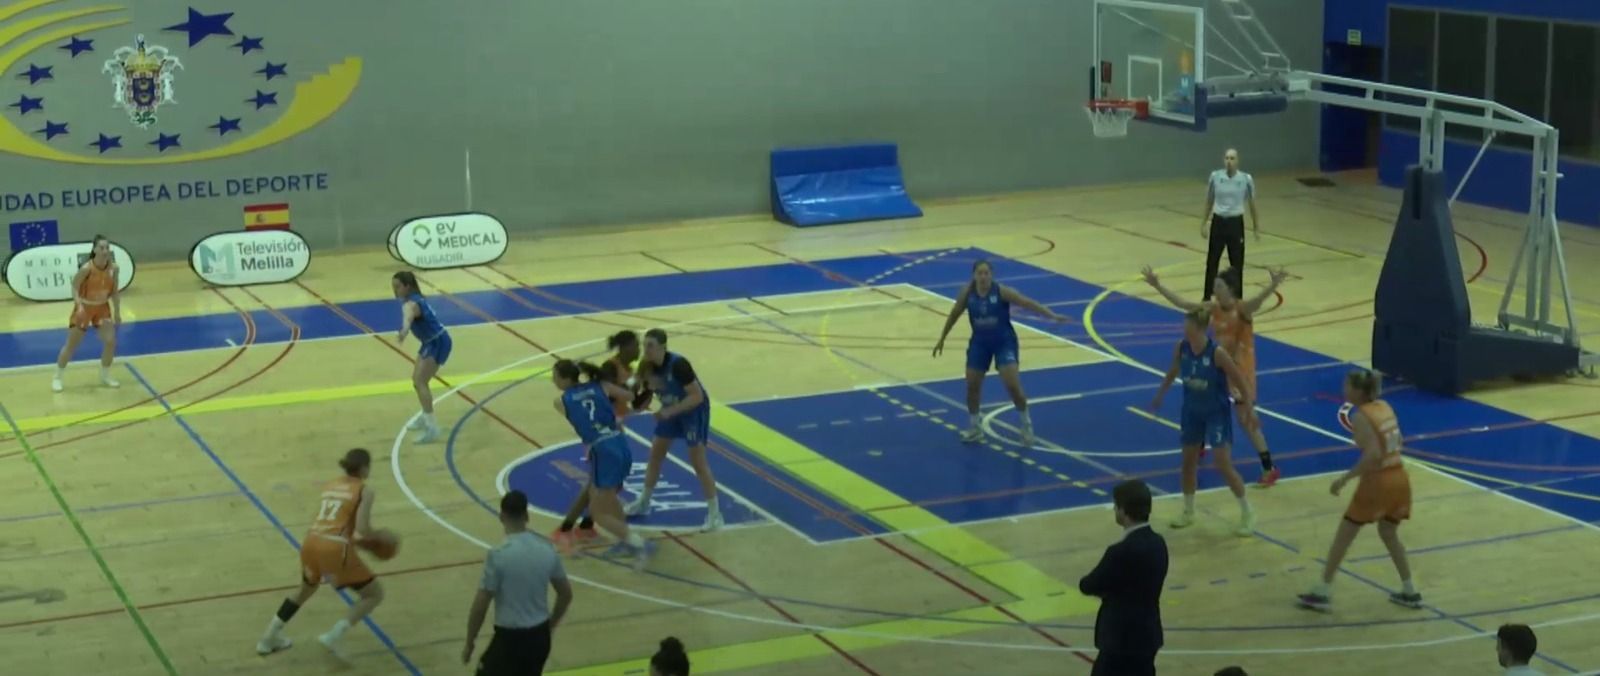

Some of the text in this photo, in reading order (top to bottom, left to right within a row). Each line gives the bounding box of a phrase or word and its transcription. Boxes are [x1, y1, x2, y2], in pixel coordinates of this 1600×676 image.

[0, 173, 328, 211] DAD EUROPEA DEL DEPORTE
[436, 221, 456, 235] ev
[236, 238, 306, 255] Televisión
[437, 232, 500, 249] MEDICAL
[241, 255, 294, 271] Melilla
[581, 399, 595, 421] 7
